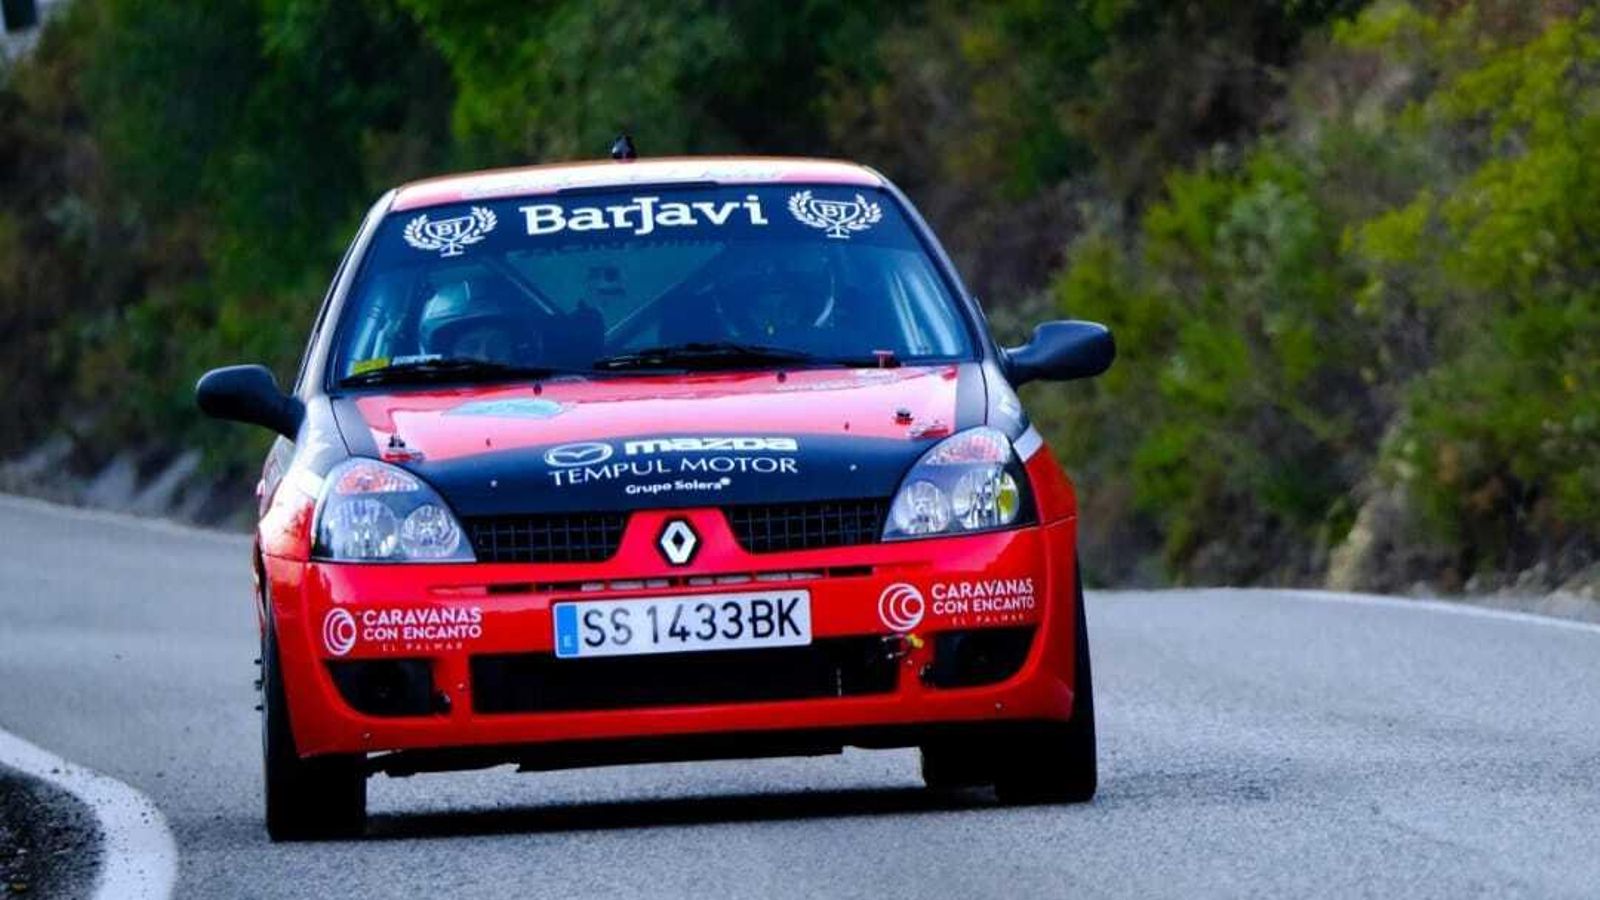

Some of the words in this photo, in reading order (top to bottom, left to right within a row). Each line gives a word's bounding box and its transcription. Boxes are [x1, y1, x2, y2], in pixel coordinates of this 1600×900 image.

[518, 195, 768, 235] BarJavi
[624, 438, 798, 456] mazda
[548, 459, 672, 487] TEMPUL
[680, 456, 798, 473] MOTOR
[625, 482, 672, 495] Grupo
[675, 479, 722, 491] Solera
[931, 578, 1034, 600] CARAVANAS
[933, 601, 968, 615] CON
[973, 596, 1035, 612] ENCANTO
[363, 607, 482, 626] CARAVANAS
[583, 607, 632, 647] SS
[646, 601, 744, 644] 1433
[749, 597, 802, 639] BK
[363, 627, 398, 640] CON
[403, 625, 482, 640] ENCANTO
